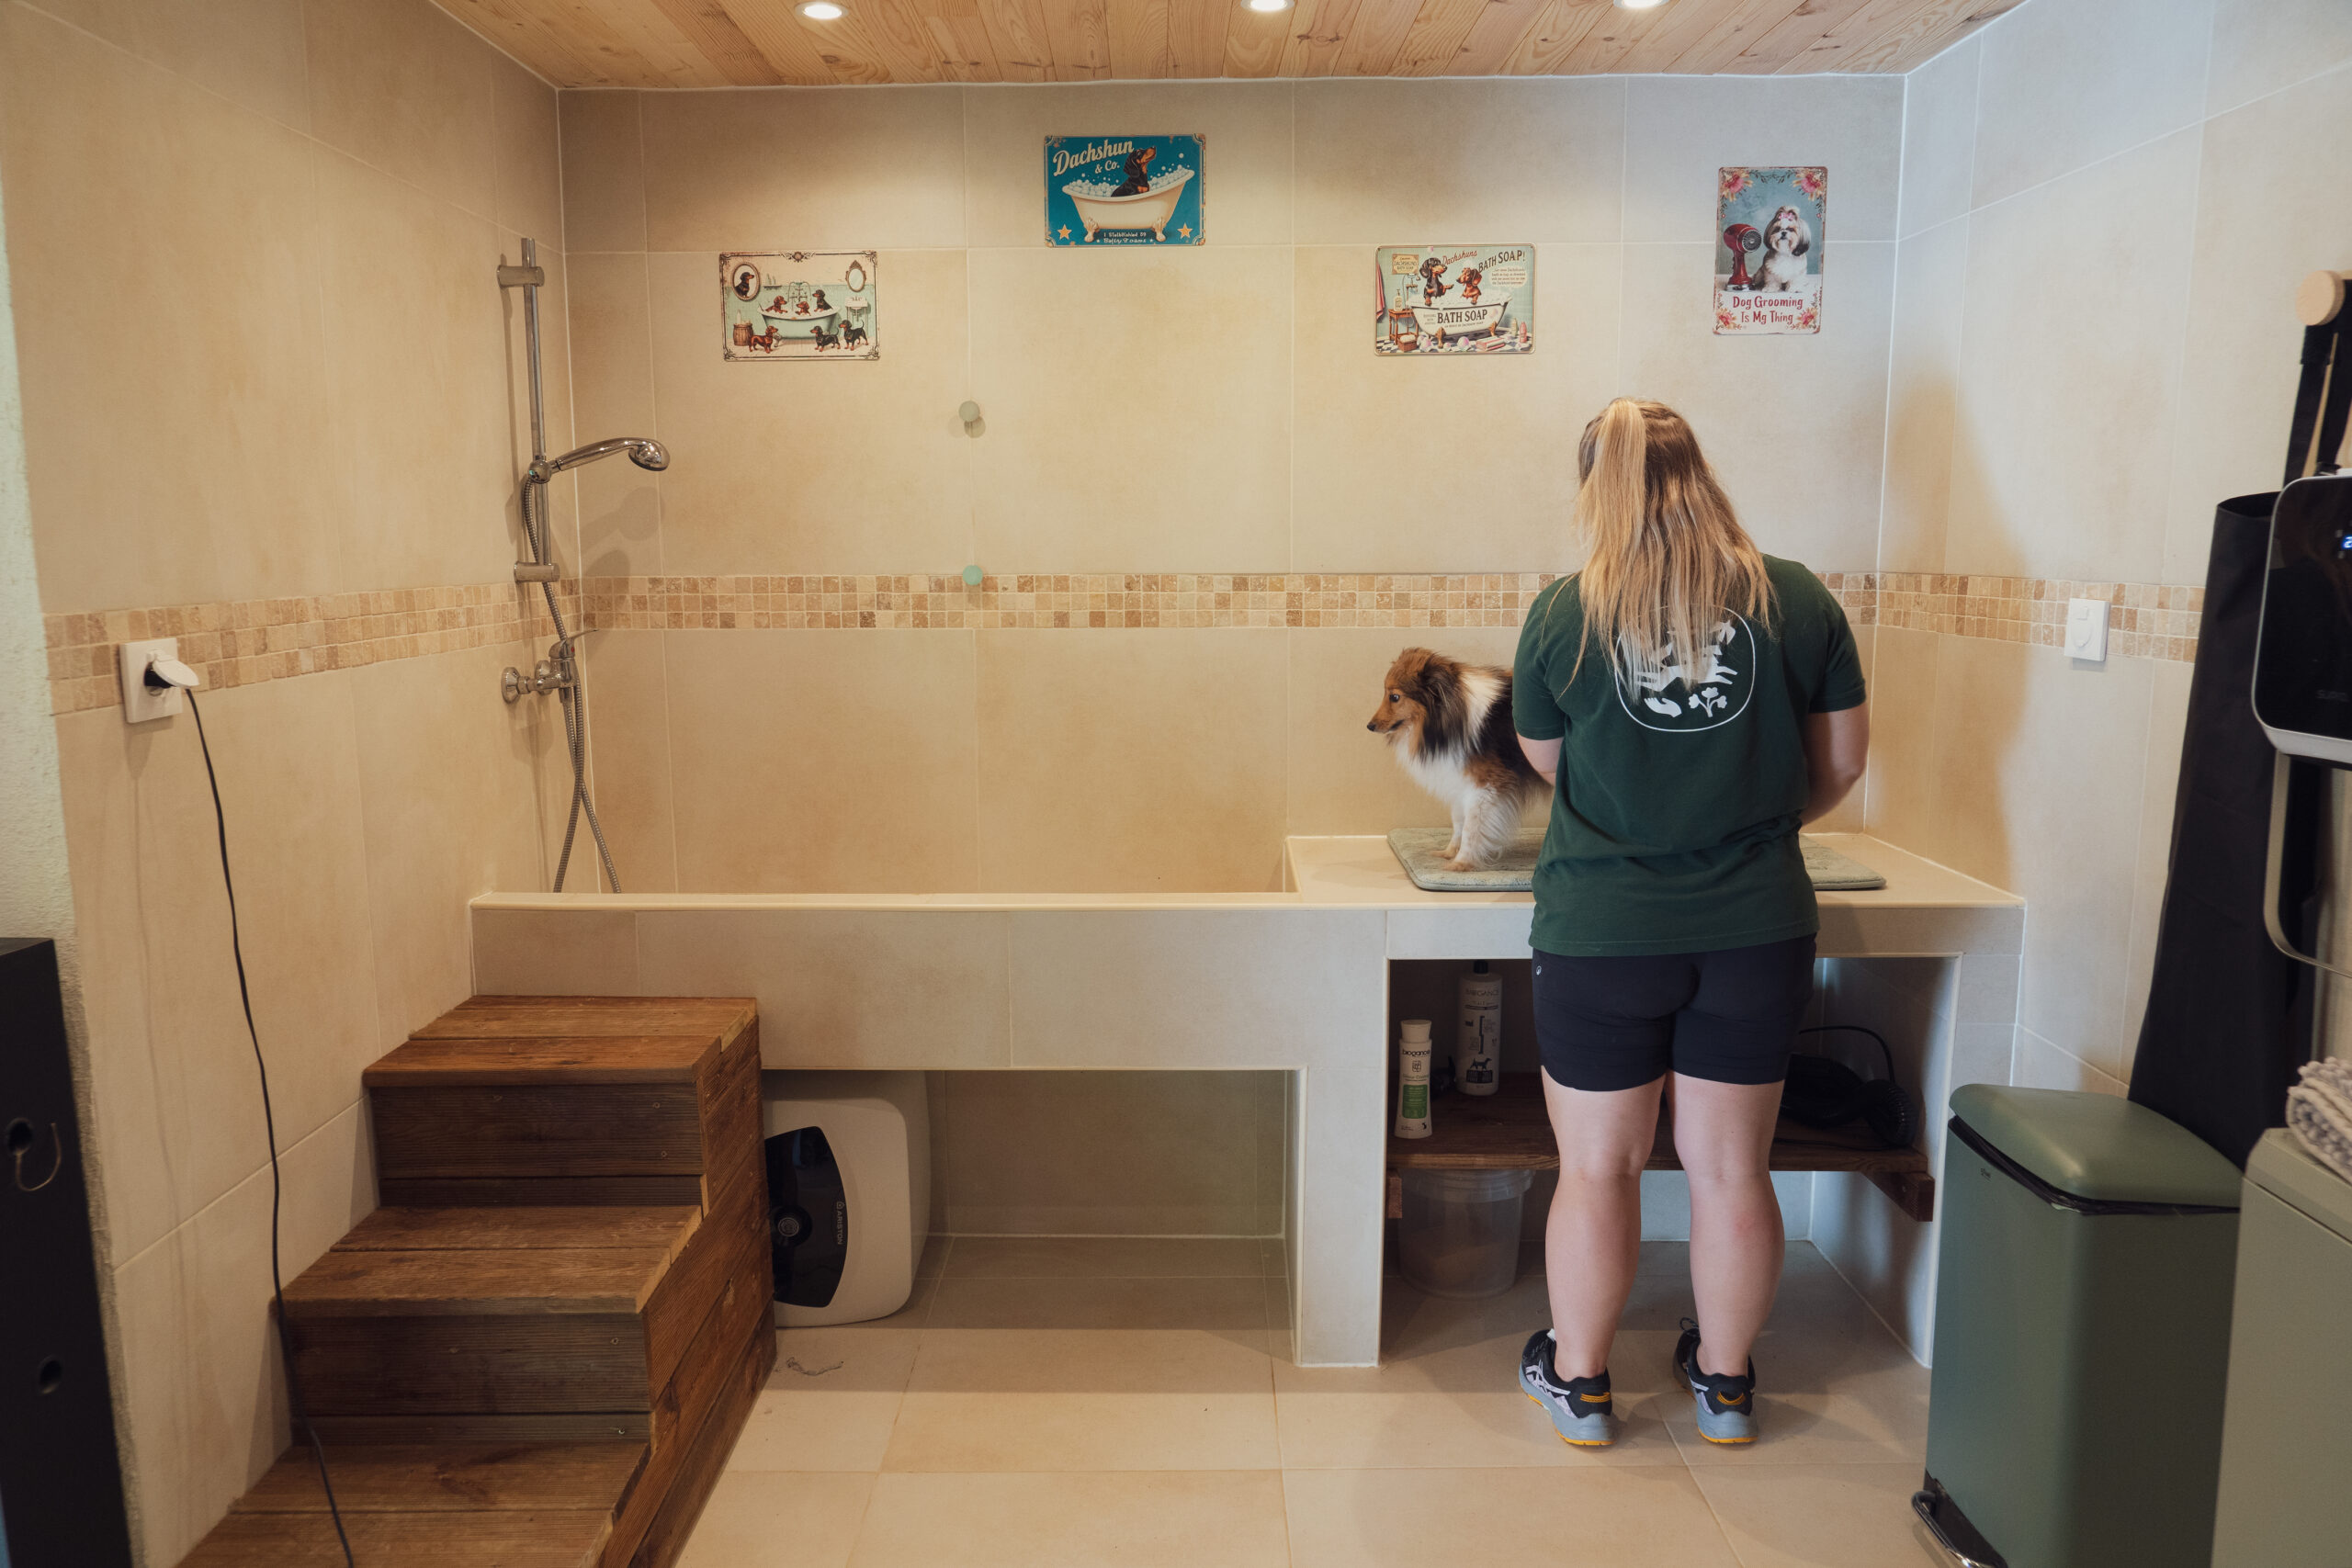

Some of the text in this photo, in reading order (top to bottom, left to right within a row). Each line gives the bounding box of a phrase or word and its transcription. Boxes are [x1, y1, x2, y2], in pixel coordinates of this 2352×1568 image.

[1053, 140, 1134, 176] Dachshun
[1094, 160, 1120, 175] & Co.
[1478, 255, 1497, 274] BATH
[1733, 296, 1804, 310] Dog Grooming
[1437, 310, 1487, 323] BATH SOAP
[1741, 311, 1749, 322] Is
[1770, 310, 1793, 325] Thing
